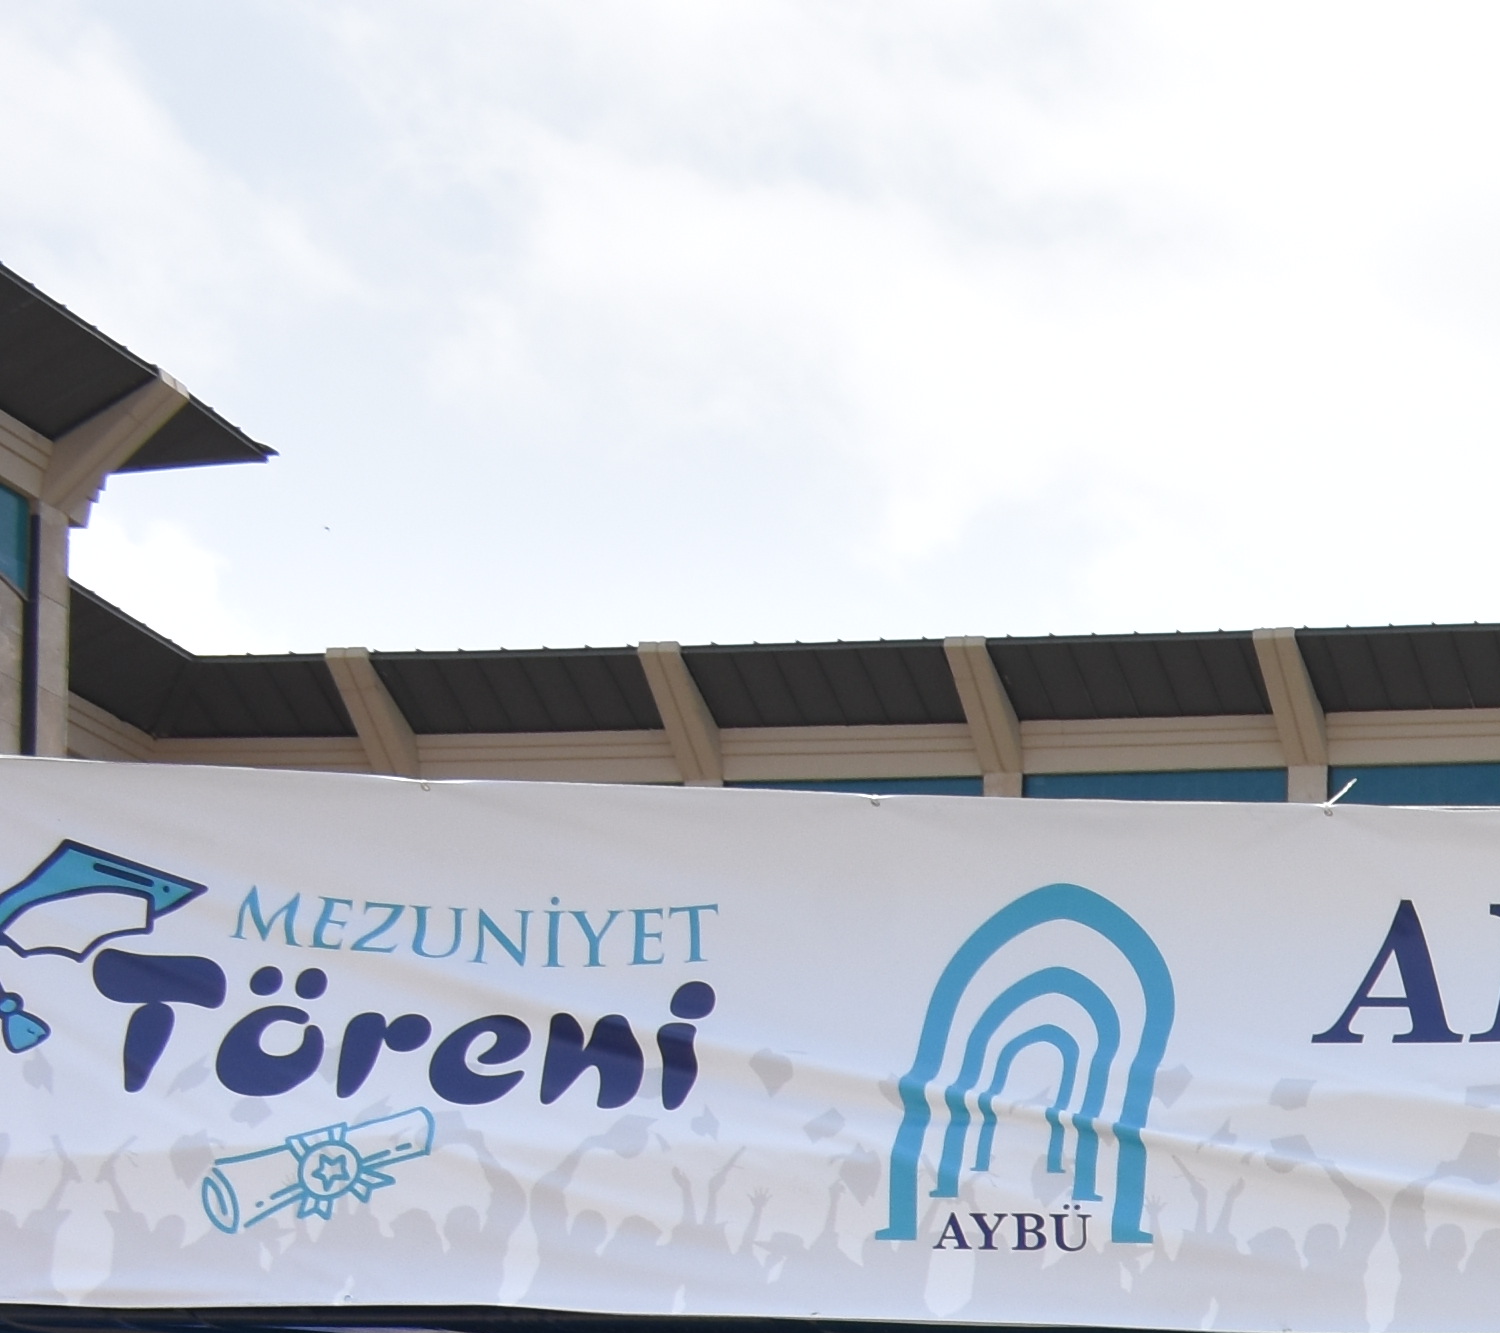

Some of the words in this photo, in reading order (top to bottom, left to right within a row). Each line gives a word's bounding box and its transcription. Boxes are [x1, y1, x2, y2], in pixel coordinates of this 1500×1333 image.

[231, 886, 719, 970] MEZUNİYET
[92, 950, 717, 1112] Töreni
[932, 1200, 1092, 1254] AYBÜ
